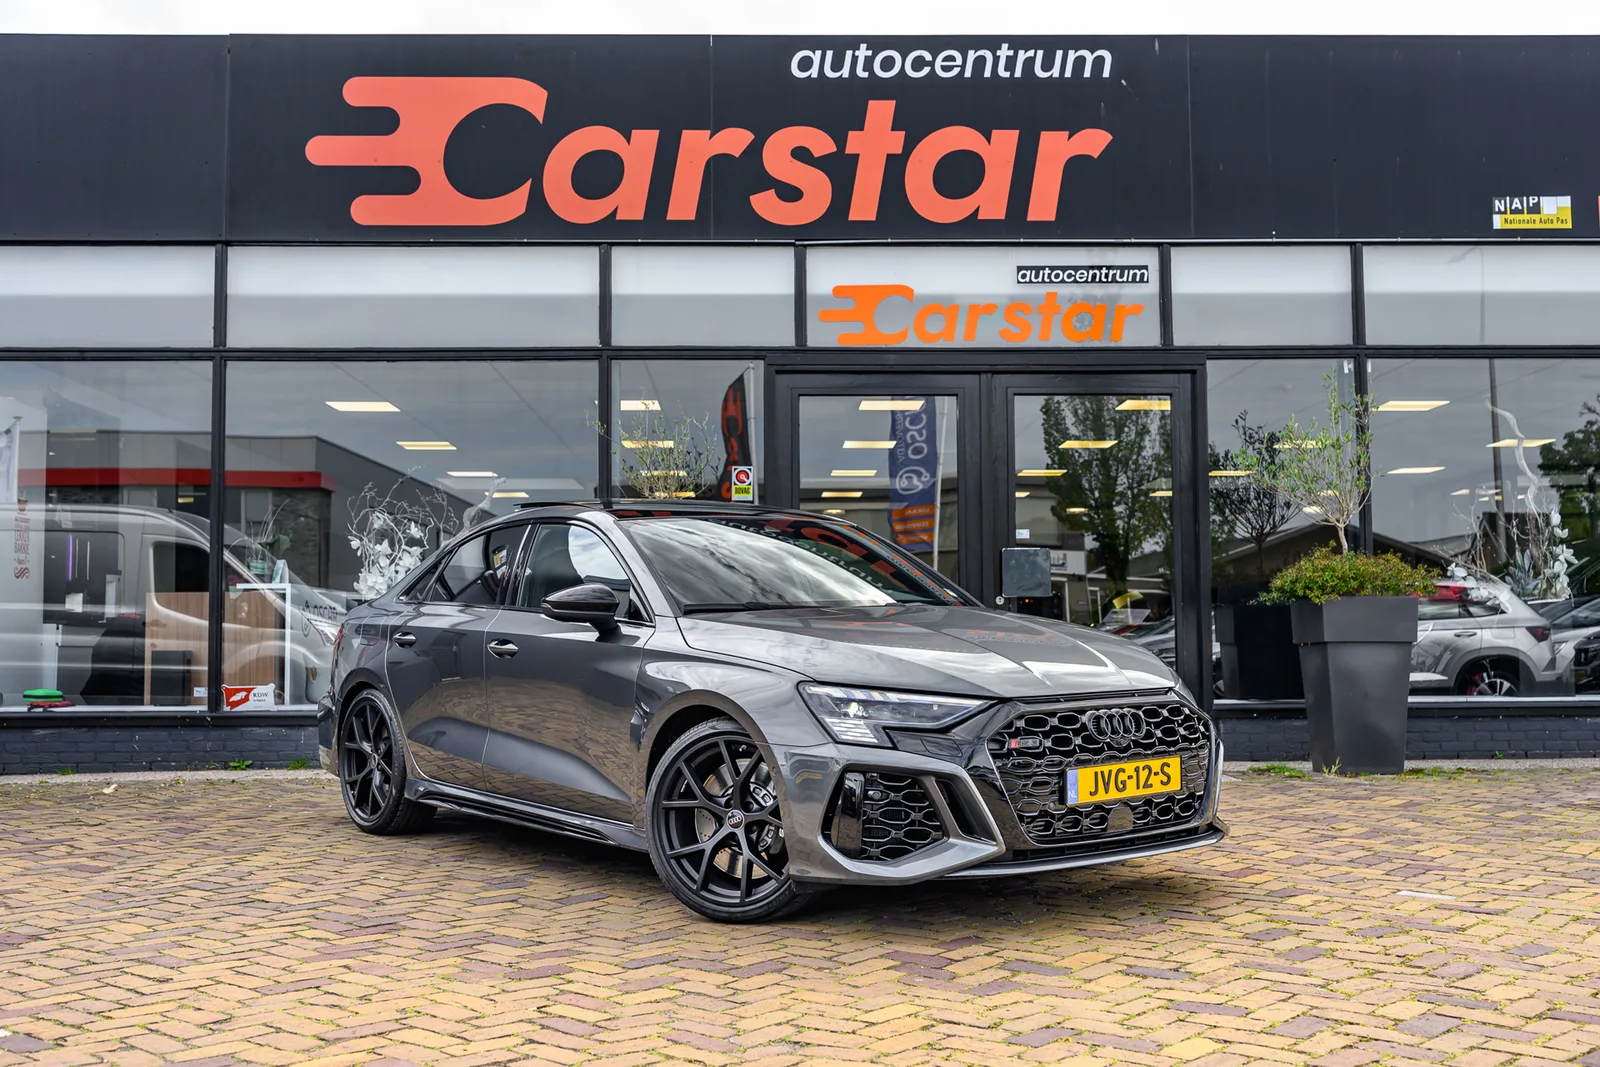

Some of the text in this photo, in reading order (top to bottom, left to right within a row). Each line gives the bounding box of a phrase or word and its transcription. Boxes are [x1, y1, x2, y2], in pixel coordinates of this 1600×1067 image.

[790, 43, 1113, 79] autocentrum
[305, 76, 1114, 226] Carstar
[1504, 217, 1568, 225] Nationale Auto Pas
[1017, 265, 1148, 283] autocentrum
[818, 284, 1145, 346] Carstar
[734, 486, 751, 495] BOVAG
[1089, 762, 1171, 797] JVG-12-S
[1068, 789, 1077, 799] NL
